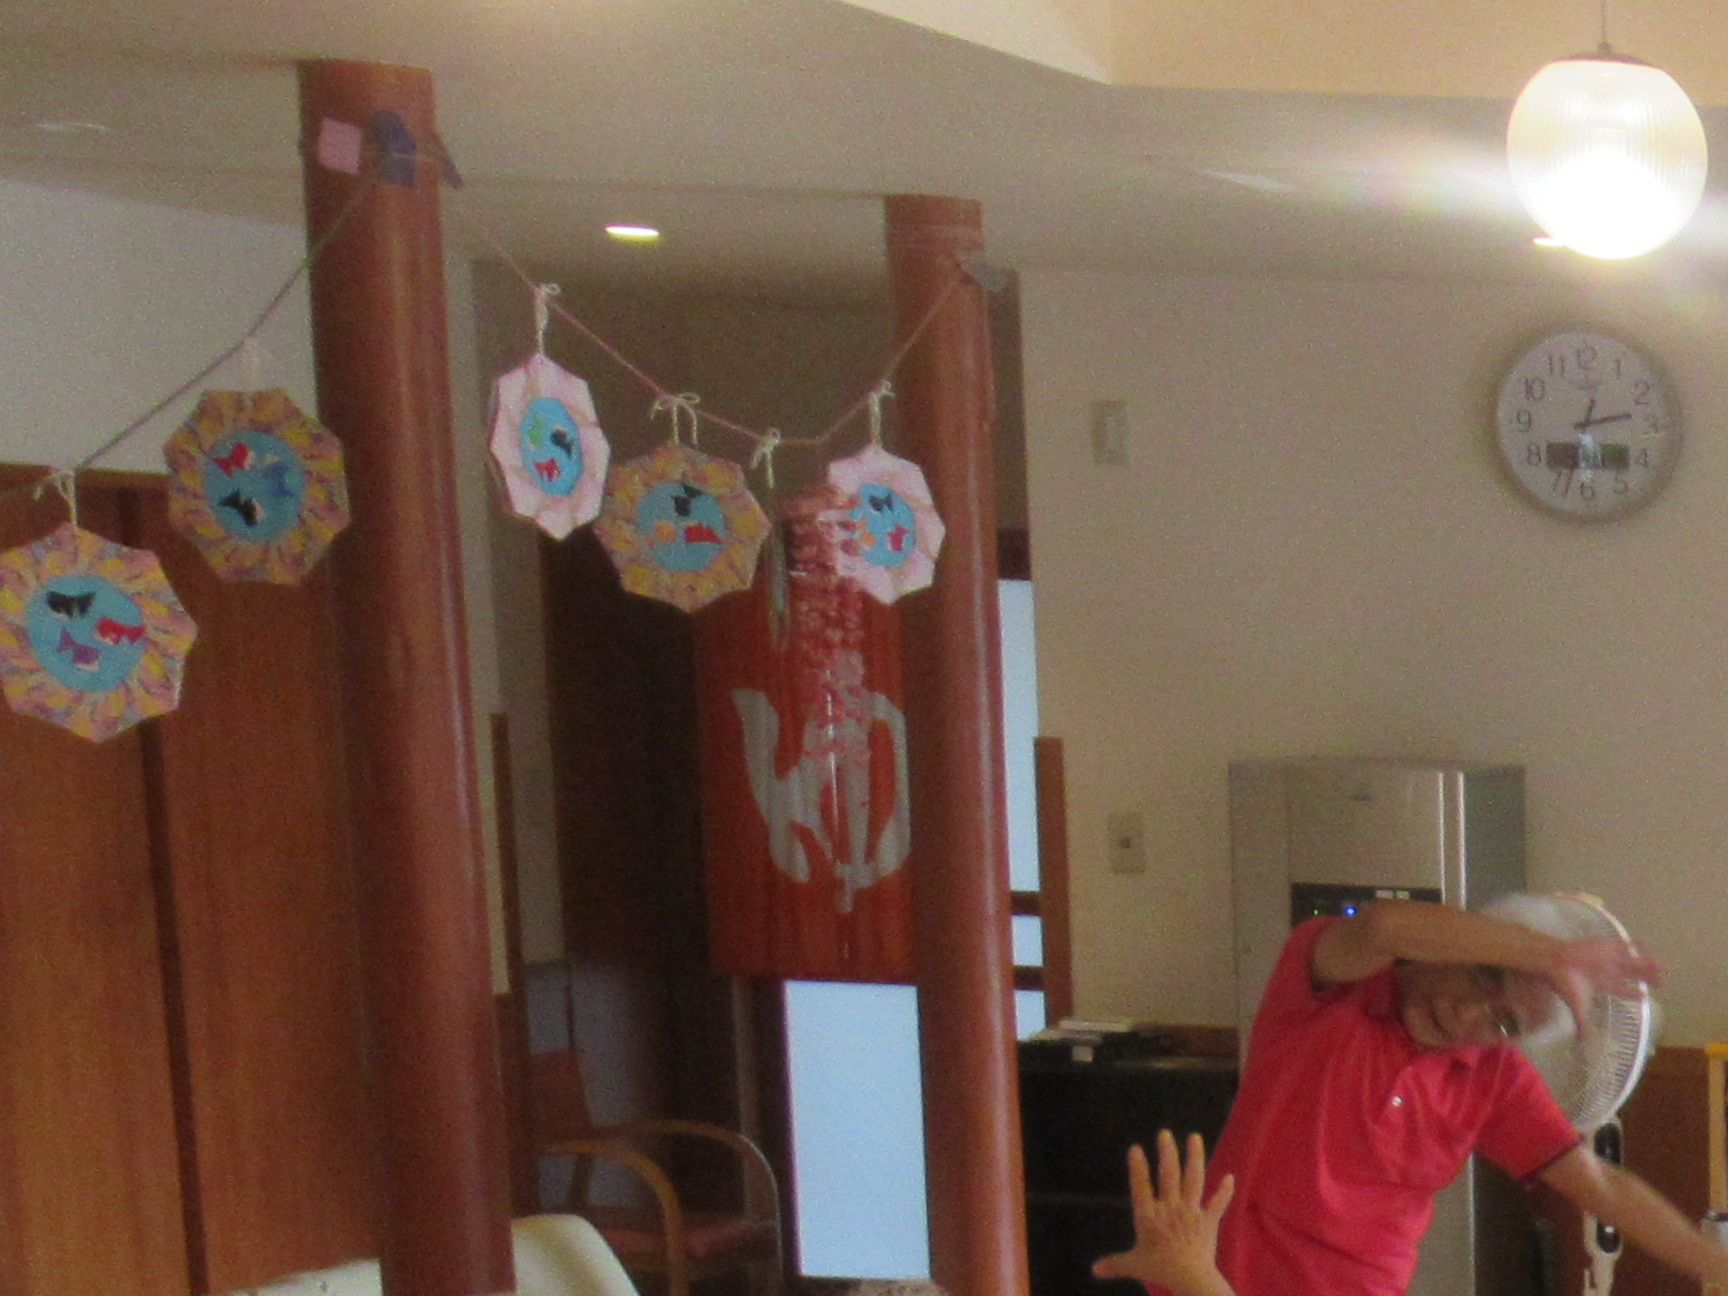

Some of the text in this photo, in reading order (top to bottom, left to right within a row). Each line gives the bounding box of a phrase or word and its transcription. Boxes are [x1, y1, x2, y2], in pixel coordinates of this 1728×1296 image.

[1548, 355, 1566, 377] 11
[1576, 346, 1597, 371] 12
[1523, 377, 1546, 402] 10
[1633, 380, 1650, 406] 2
[1516, 409, 1533, 433] 9
[1526, 443, 1542, 467] 8
[1635, 447, 1649, 468] 4
[1580, 477, 1596, 501] 6
[1613, 469, 1629, 495] 5
